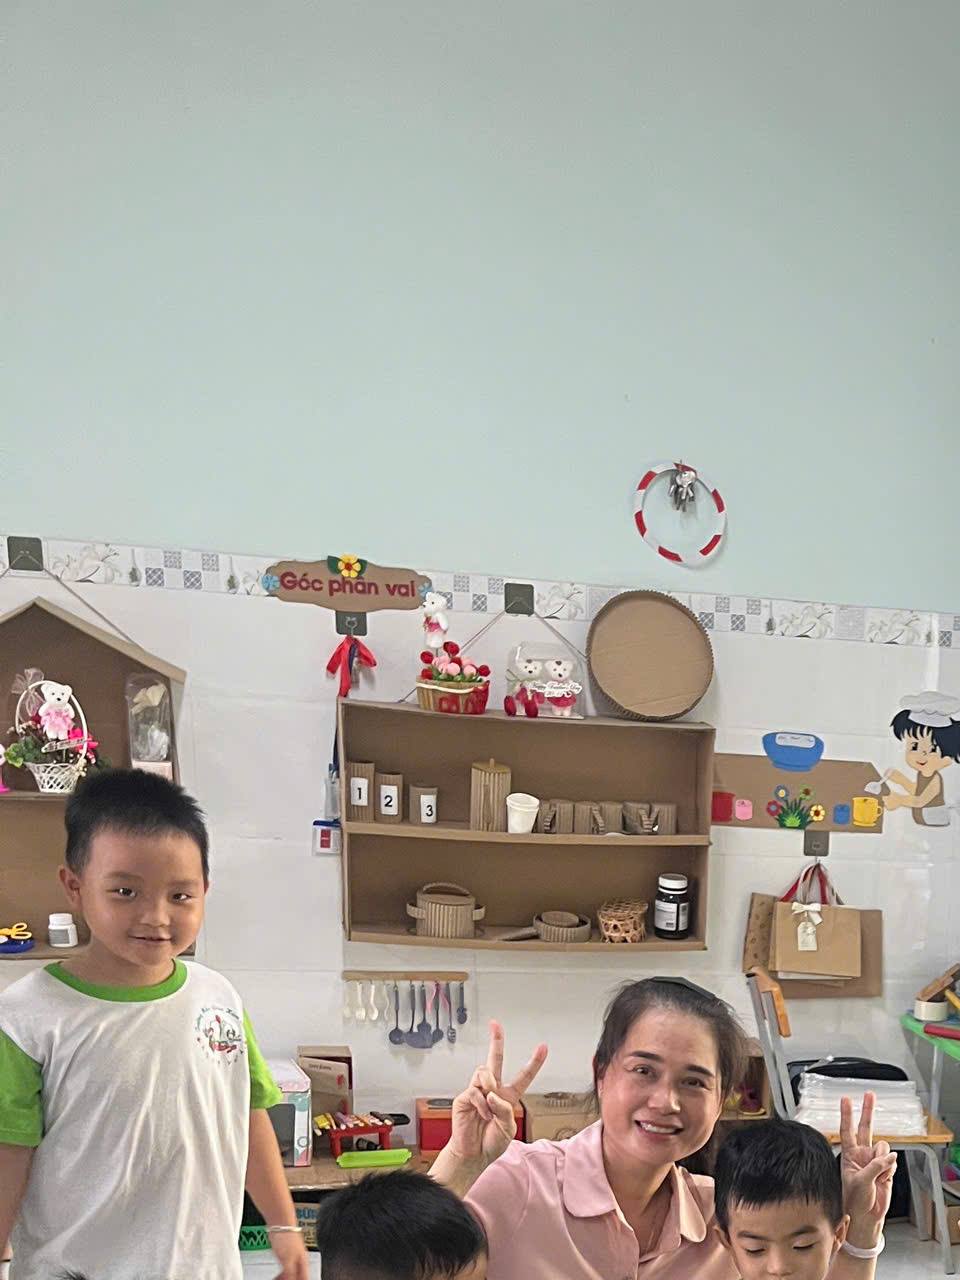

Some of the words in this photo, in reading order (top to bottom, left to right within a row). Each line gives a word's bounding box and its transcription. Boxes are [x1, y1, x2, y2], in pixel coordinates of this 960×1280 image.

[279, 571, 323, 592] Góc
[328, 576, 379, 596] phân
[385, 580, 416, 597] vai
[357, 787, 362, 800] 1
[384, 795, 393, 808] 2
[425, 804, 433, 817] 3
